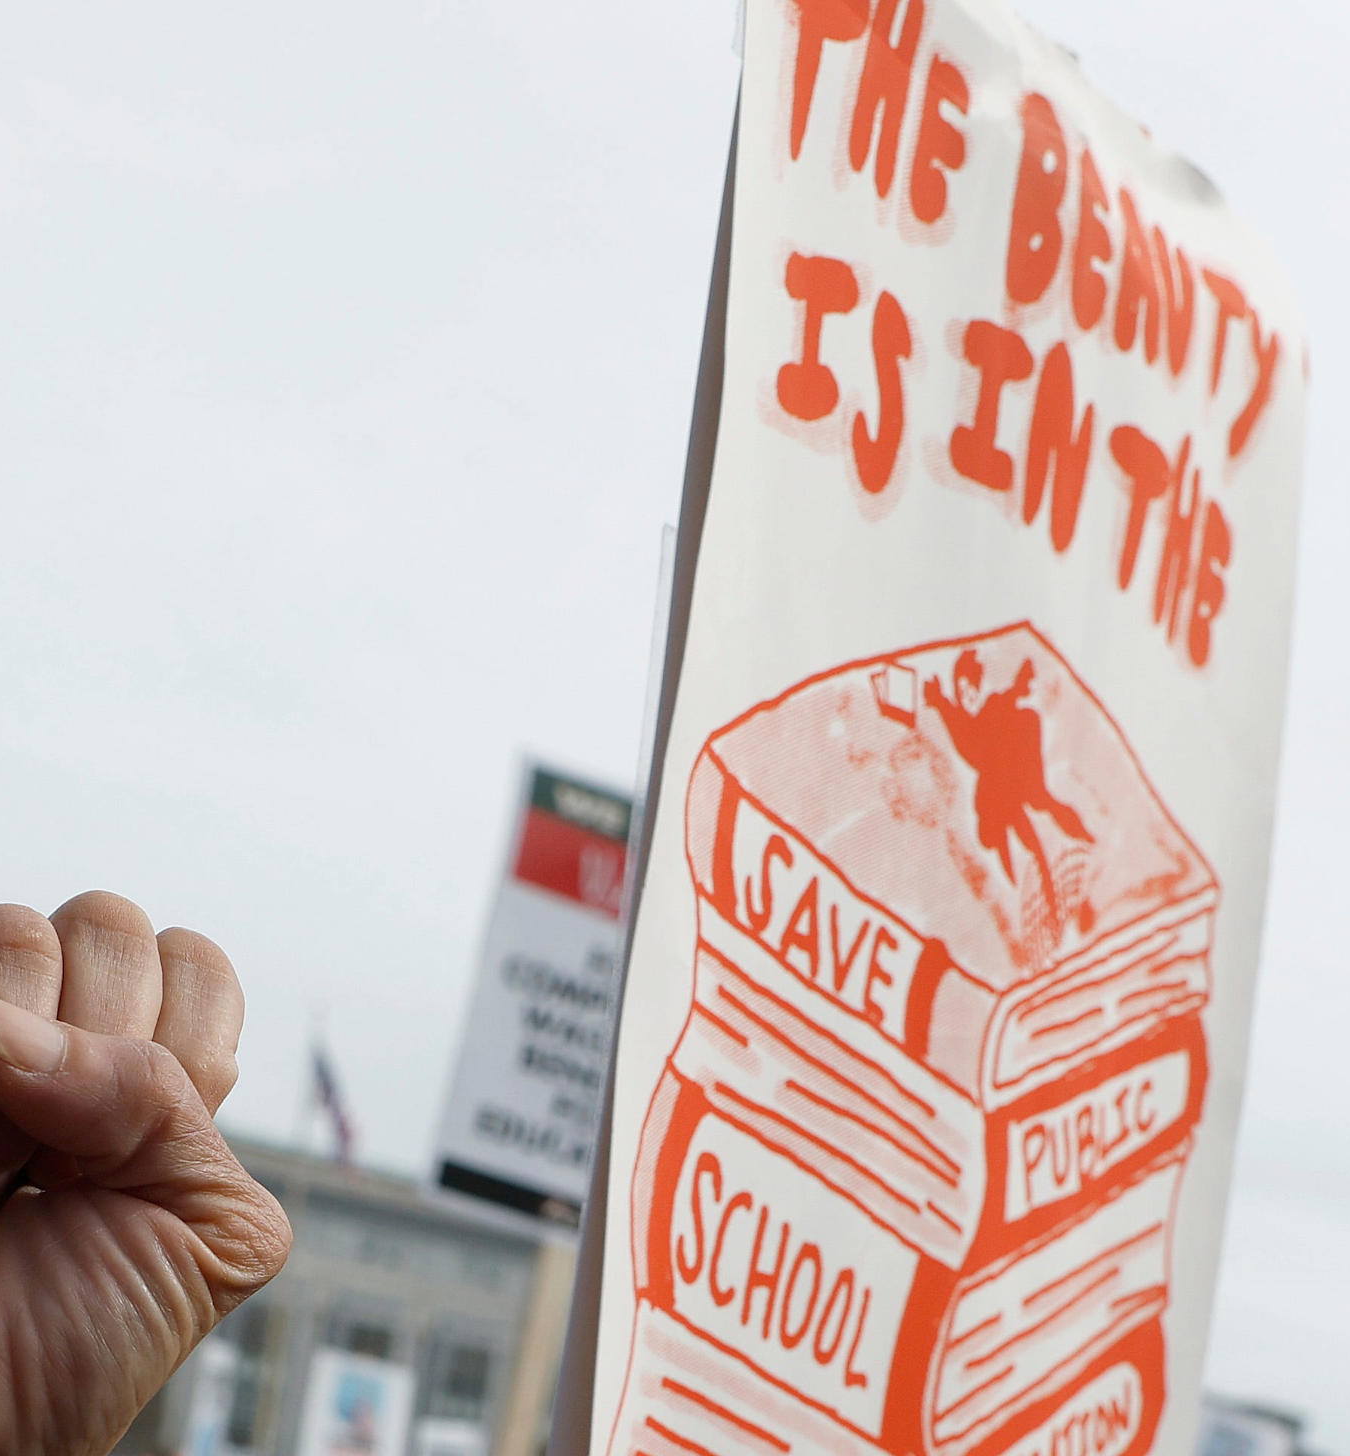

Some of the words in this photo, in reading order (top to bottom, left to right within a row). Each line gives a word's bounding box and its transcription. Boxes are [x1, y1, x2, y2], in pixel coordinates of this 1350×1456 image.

[790, 0, 971, 224] THE
[1005, 92, 1280, 459] BEAUTY
[776, 251, 913, 494] IS
[948, 318, 1095, 555] IN
[1107, 423, 1234, 669] THE
[744, 834, 899, 1025] SAVE
[1021, 1077, 1159, 1203] PUBLIC
[675, 1151, 878, 1389] SCHOOL
